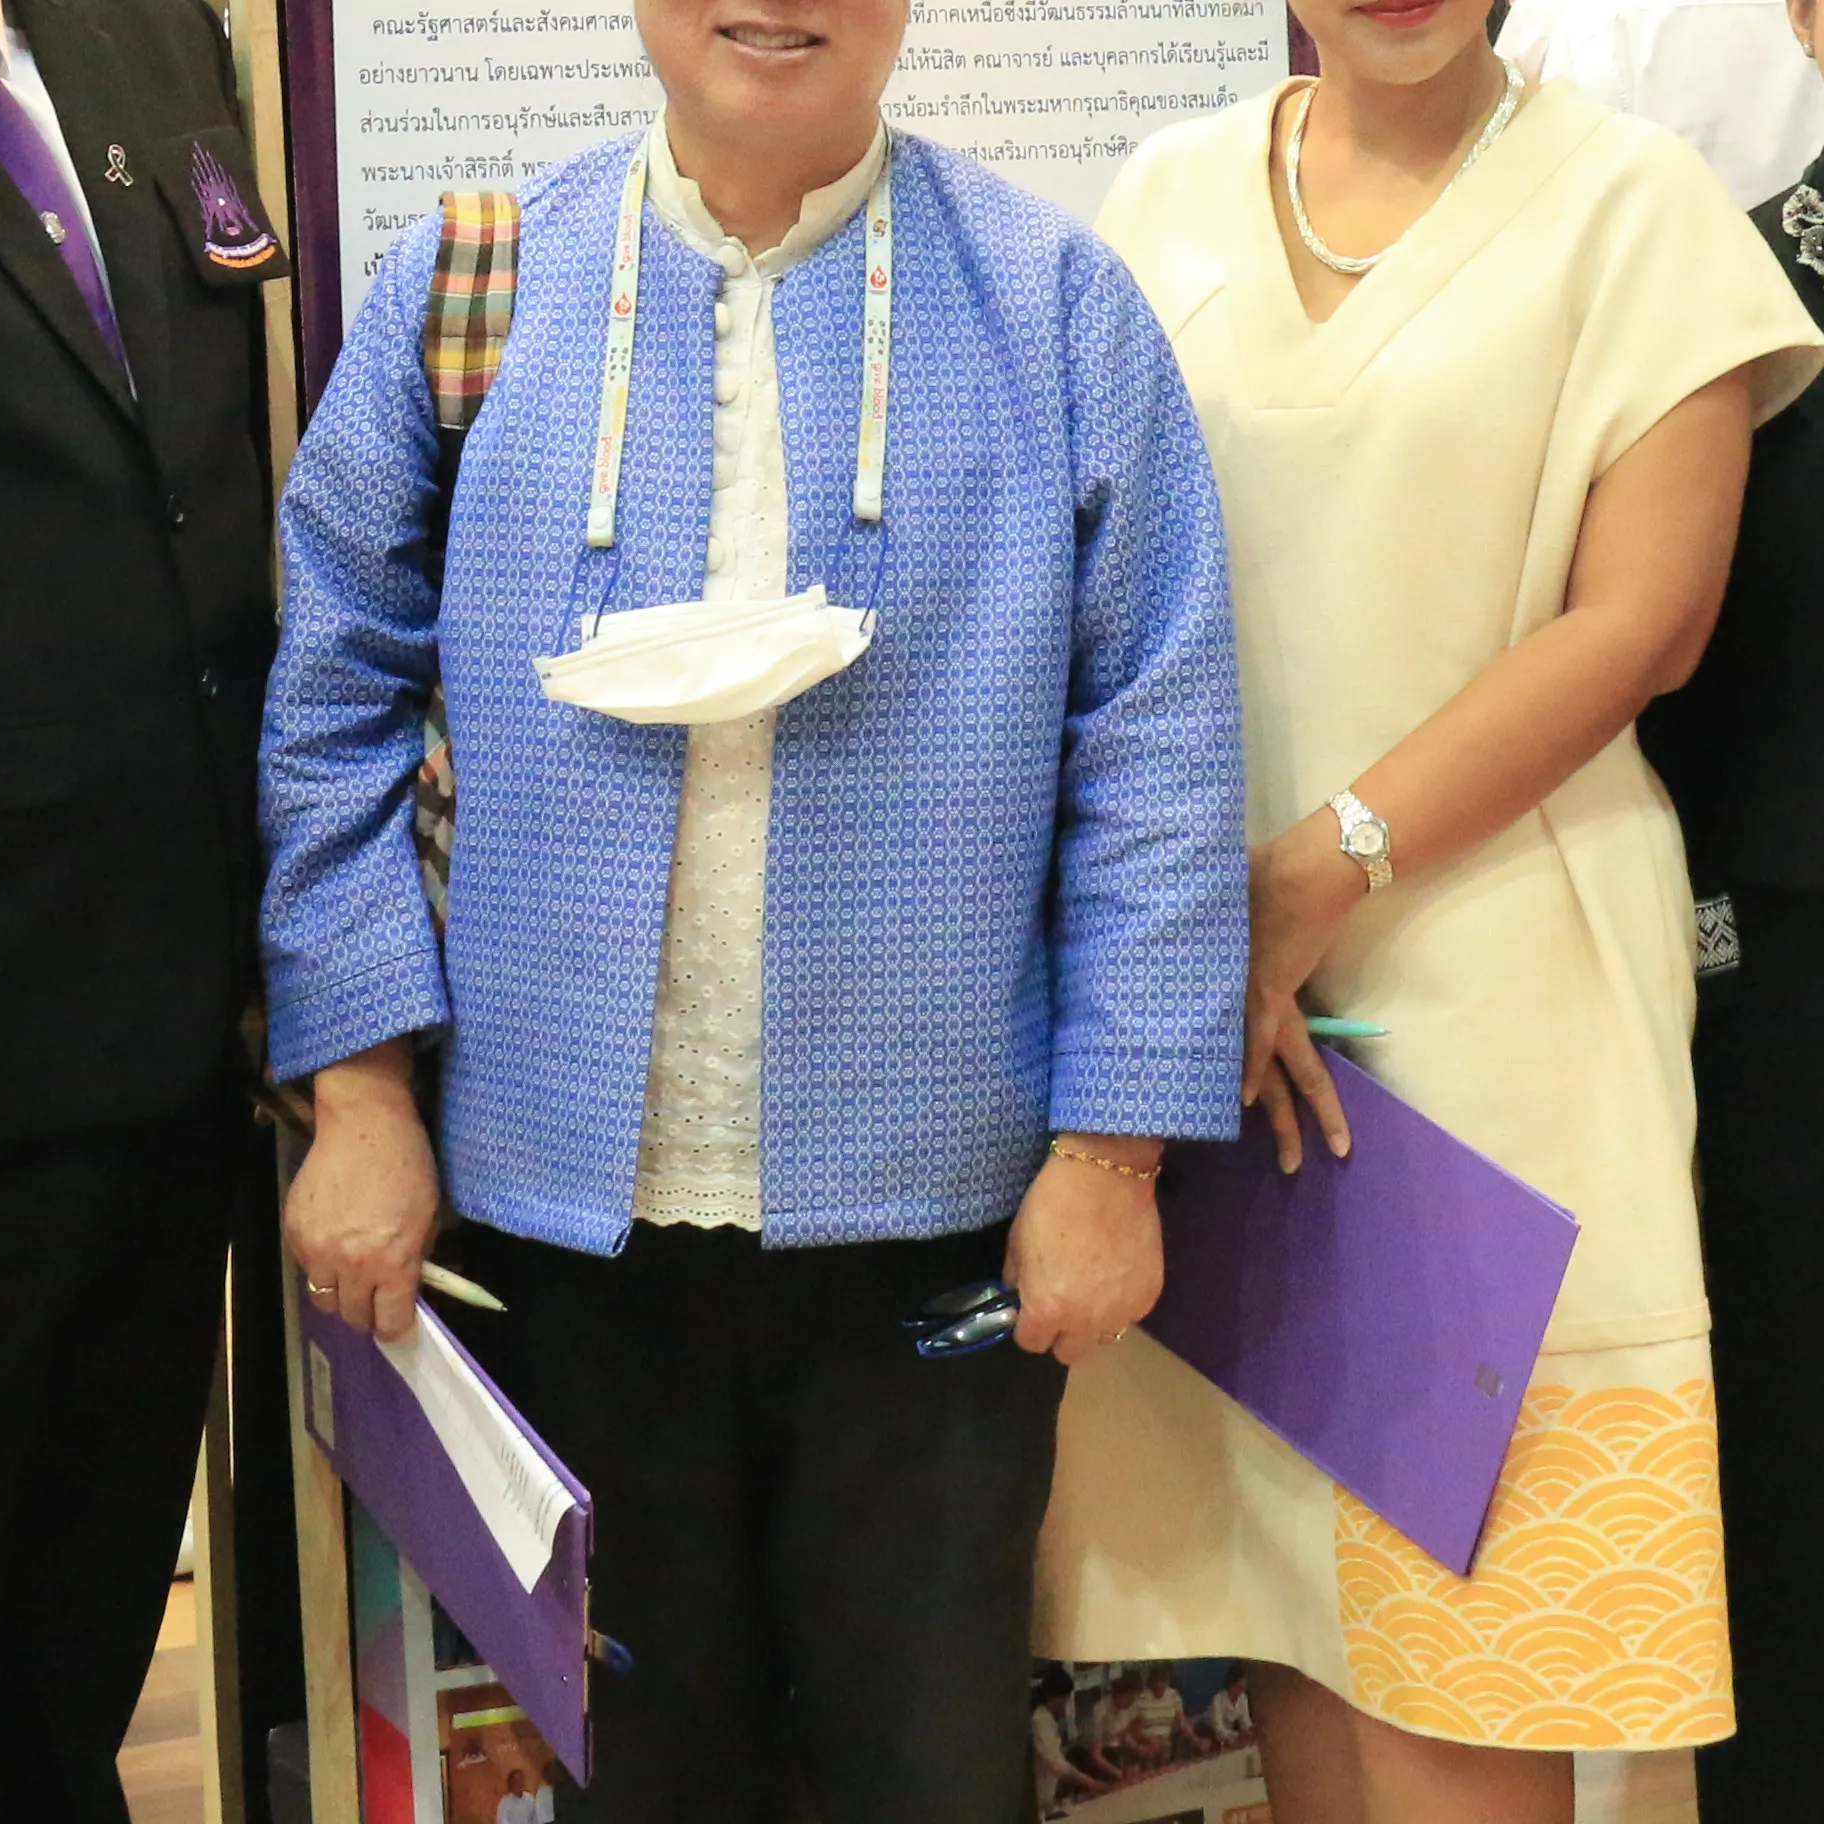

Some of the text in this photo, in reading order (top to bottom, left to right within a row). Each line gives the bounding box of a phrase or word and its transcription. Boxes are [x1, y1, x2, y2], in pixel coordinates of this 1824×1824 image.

[359, 60, 479, 84] อย่างยาวนาน
[892, 40, 1269, 73] มให้นิสิต คณาจารย์ และบุคลากรได้เรียนรู้และมี
[361, 149, 514, 182] พระนางเจ้าสิริกิติ์
[598, 435, 613, 494] give blood
